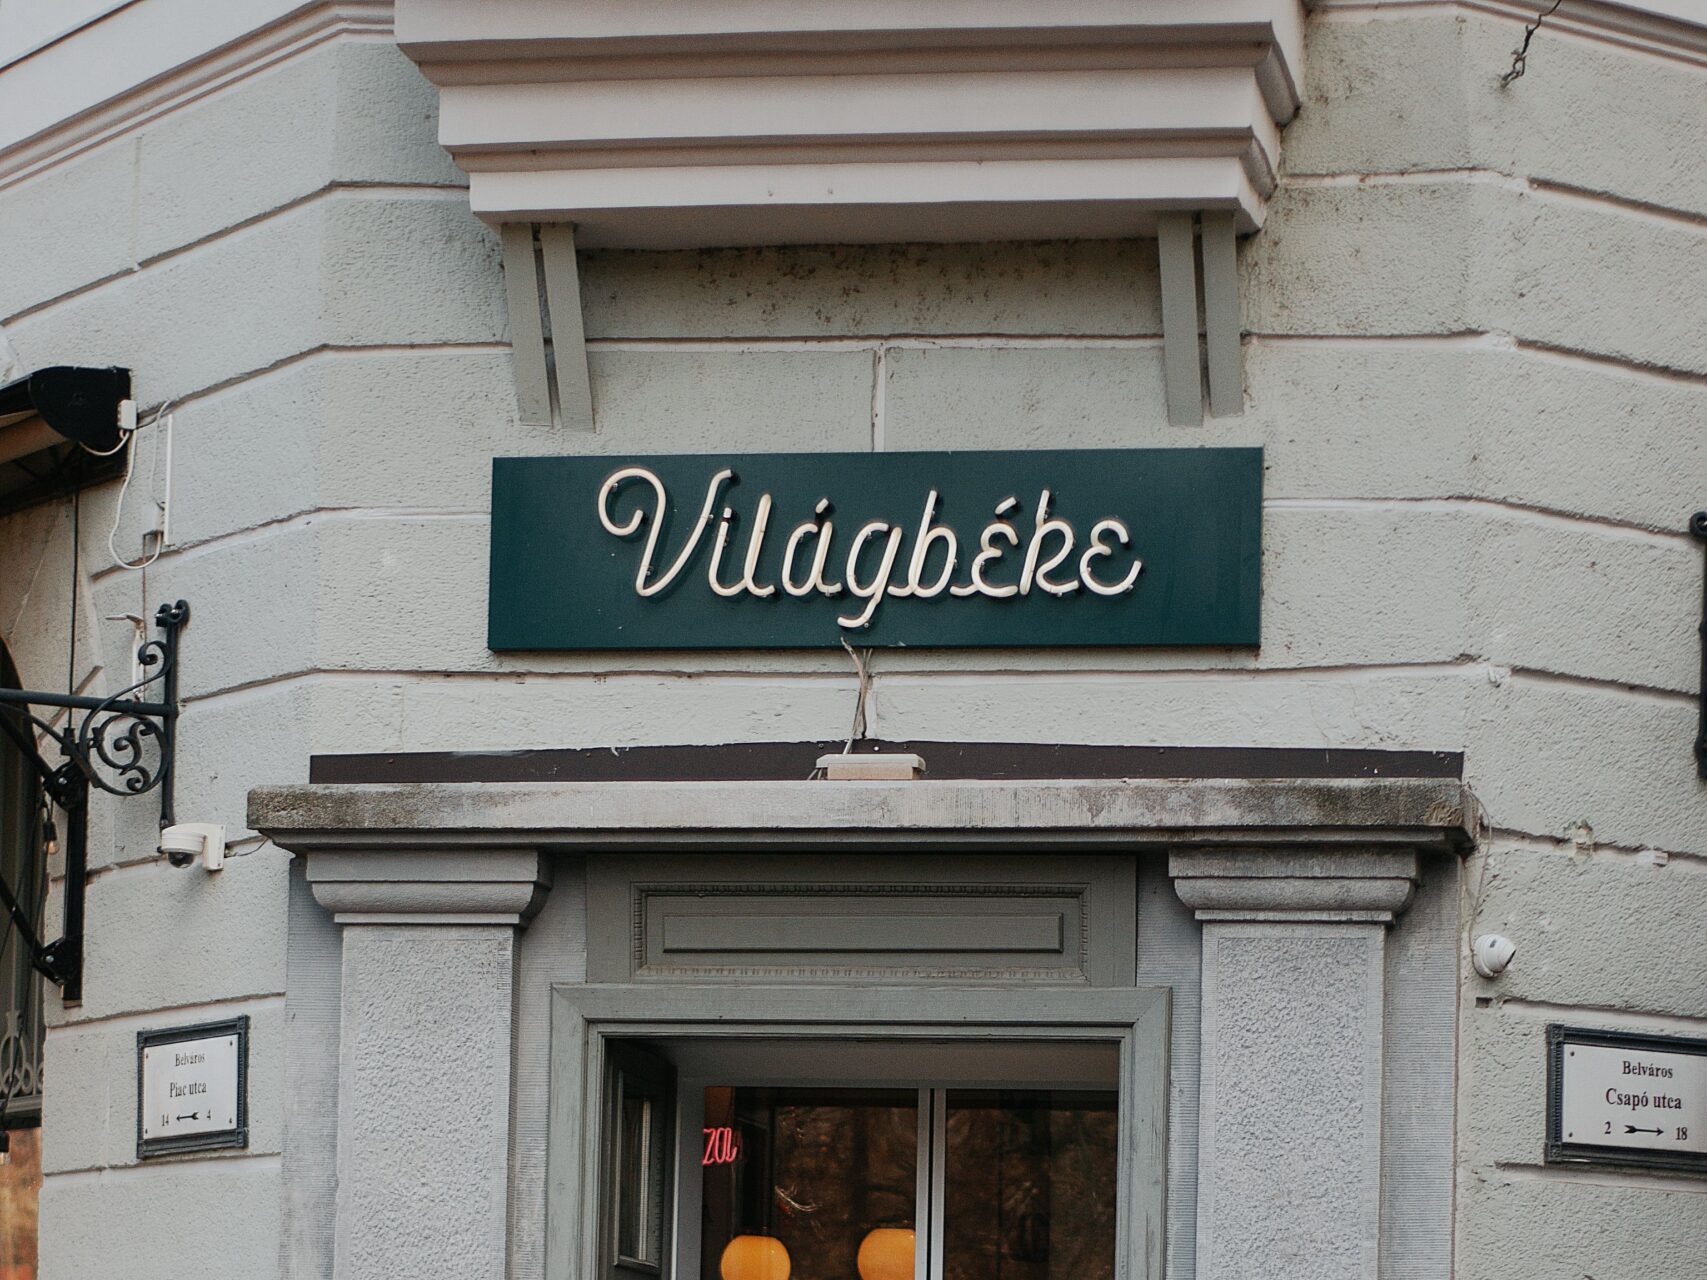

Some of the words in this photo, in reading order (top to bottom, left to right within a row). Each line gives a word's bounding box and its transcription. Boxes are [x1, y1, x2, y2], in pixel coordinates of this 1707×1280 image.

[597, 467, 1143, 629] Világbéke
[1622, 1060, 1674, 1079] Belváros
[169, 1082, 187, 1098] Piac
[188, 1082, 208, 1095] utca
[1605, 1088, 1649, 1111] Csapó
[1653, 1093, 1682, 1110] utca
[161, 1114, 170, 1127] 14
[206, 1109, 212, 1121] 4
[1604, 1121, 1612, 1135] 2
[1675, 1126, 1689, 1141] 18
